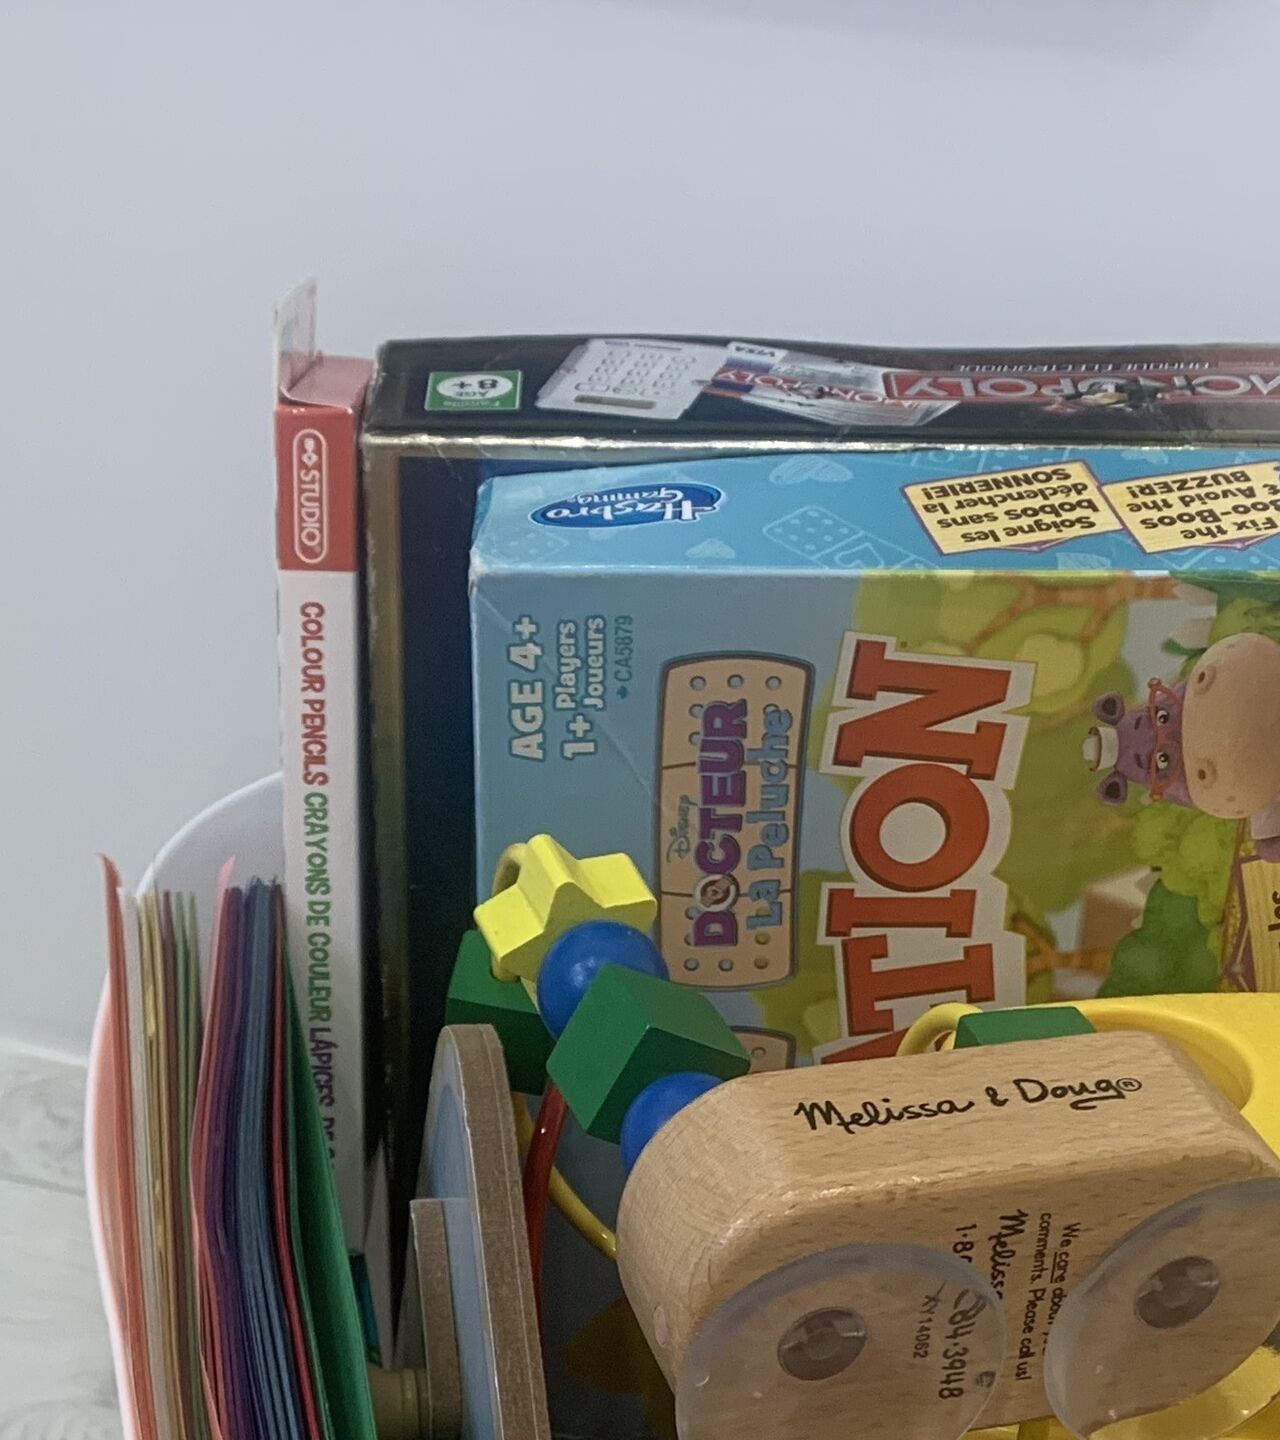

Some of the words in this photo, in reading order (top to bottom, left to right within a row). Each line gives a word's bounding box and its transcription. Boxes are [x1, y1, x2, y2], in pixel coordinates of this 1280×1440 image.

[451, 378, 499, 390] 8+
[577, 487, 684, 505] Gaming
[921, 467, 1072, 500] SONNERIE!
[955, 482, 1089, 510] déclencher
[1126, 469, 1252, 499] BUZZER!
[1177, 484, 1257, 509] Avoid
[300, 468, 322, 548] STUDIO
[545, 499, 715, 521] Hasbro
[921, 501, 950, 515] la
[936, 511, 999, 529] sans
[1004, 498, 1100, 520] bobos
[1125, 499, 1174, 513] the
[960, 529, 1001, 543] les
[1003, 515, 1097, 538] Soigne
[1179, 525, 1229, 540] the
[1232, 516, 1279, 532] Fix
[299, 601, 325, 692] COLOUR
[509, 616, 541, 671] 4+
[614, 615, 633, 682] CA5879
[556, 621, 581, 709] Players
[583, 616, 605, 709] Joueurs
[510, 681, 544, 760] AGE
[563, 714, 595, 757] 1+
[301, 696, 328, 786] PENCILS
[746, 708, 793, 871] Peluche
[693, 698, 748, 947] DOCTEUR
[303, 791, 331, 894] CRAYONS
[306, 899, 331, 929] DE
[746, 879, 783, 930] La
[306, 930, 332, 1022] COULEUR
[794, 1097, 975, 1134] Melissa
[1029, 1211, 1052, 1285] comments.
[1059, 1221, 1081, 1249] We
[1051, 1251, 1070, 1284] care
[1022, 1287, 1046, 1335] Please
[1047, 1286, 1068, 1325] abou
[1017, 1337, 1036, 1364] call
